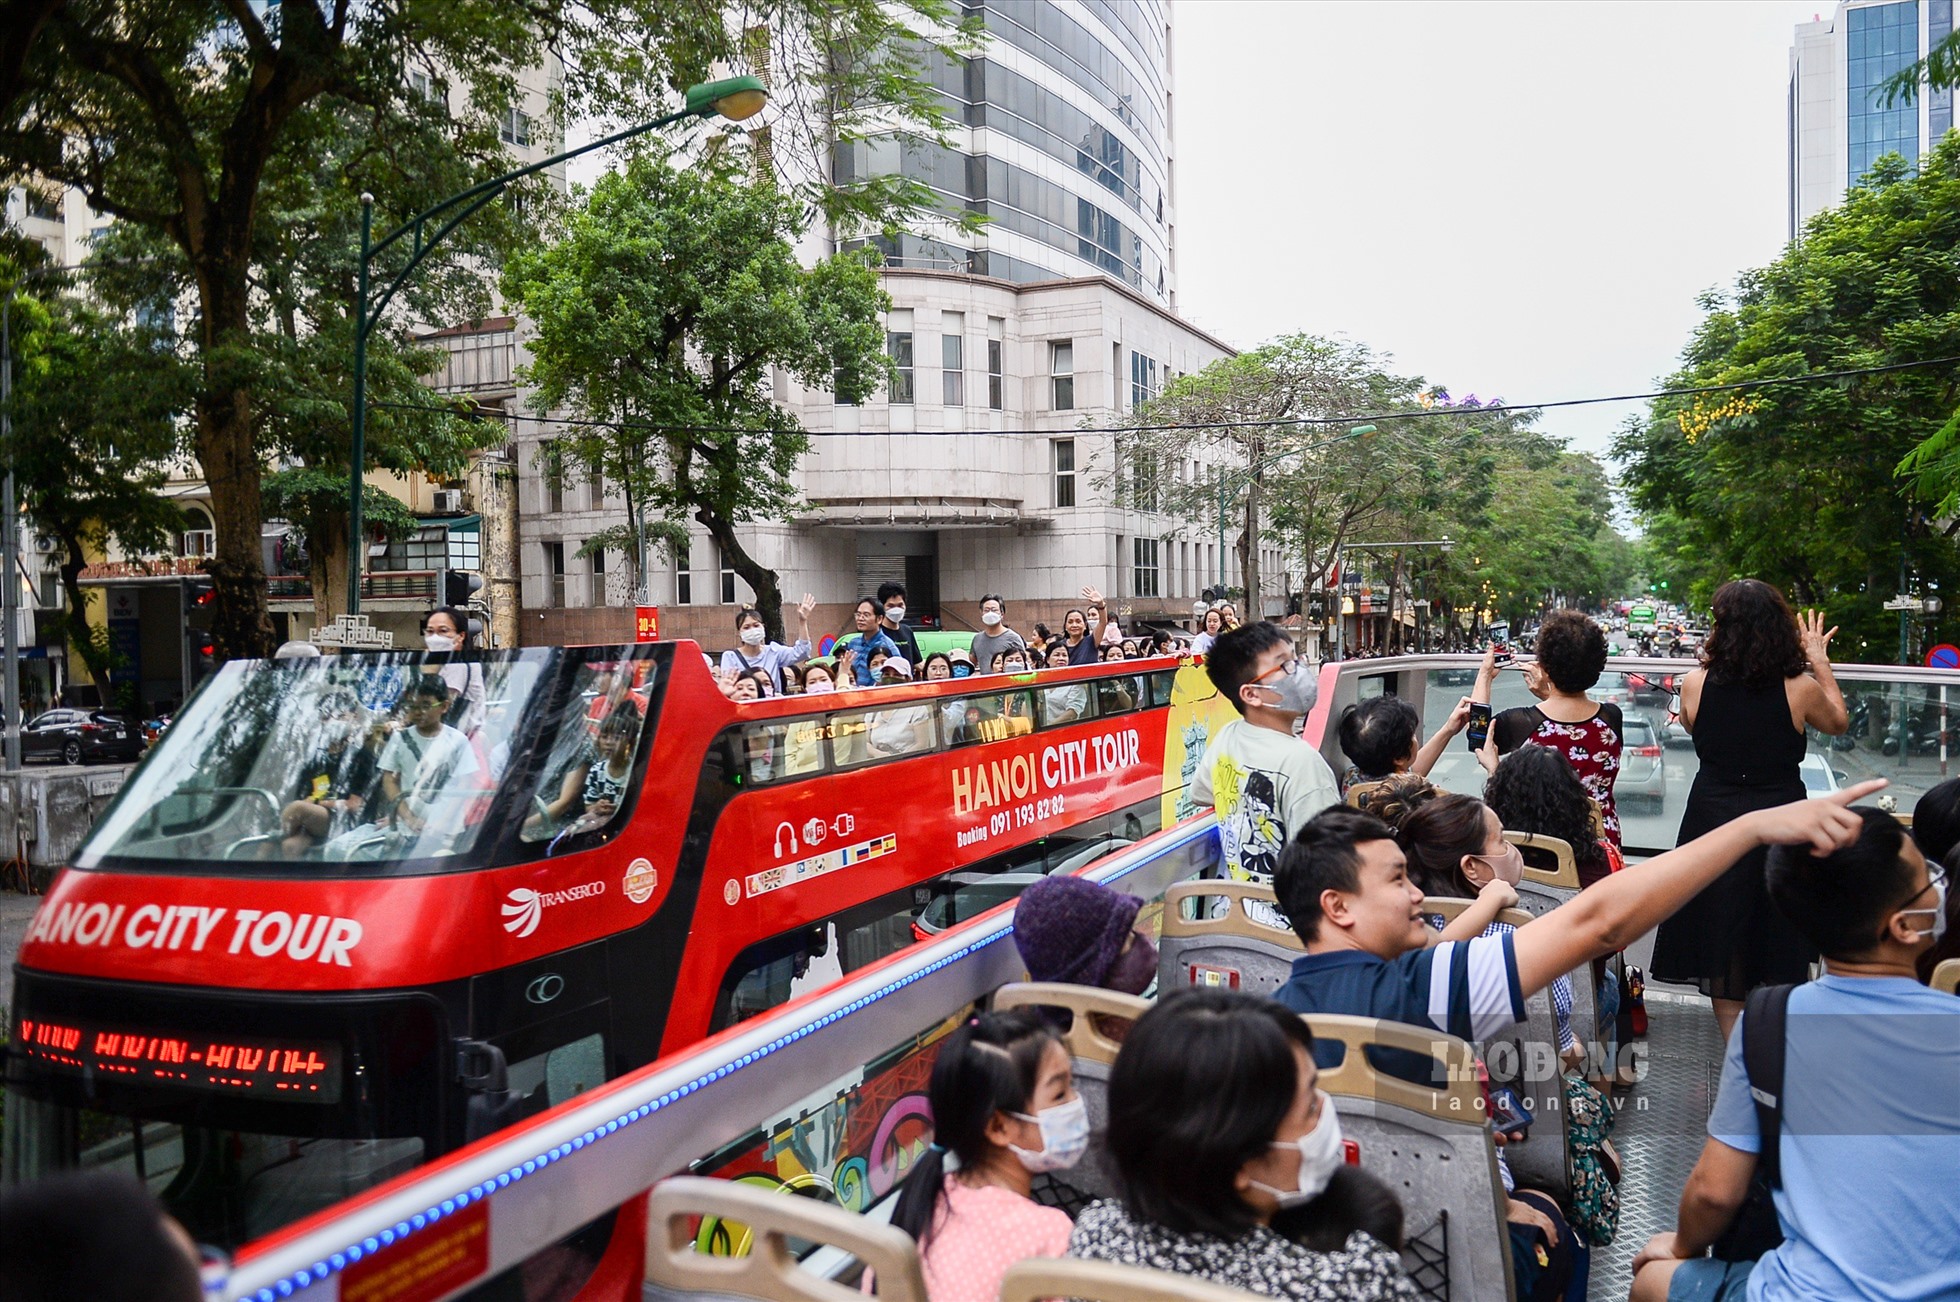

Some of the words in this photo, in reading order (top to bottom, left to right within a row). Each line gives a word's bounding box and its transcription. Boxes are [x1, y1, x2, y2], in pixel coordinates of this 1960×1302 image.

[952, 752, 1037, 816] HANOI
[1042, 739, 1087, 789] CITY
[1091, 728, 1140, 775] TOUR
[957, 825, 987, 848] Booking
[991, 812, 1011, 836] 091
[1015, 803, 1035, 828] 193
[1037, 799, 1050, 821] 82
[1052, 794, 1065, 815] 82
[540, 880, 606, 908] TRANSERCO
[124, 904, 227, 952] CITY
[228, 909, 363, 967] TOUR
